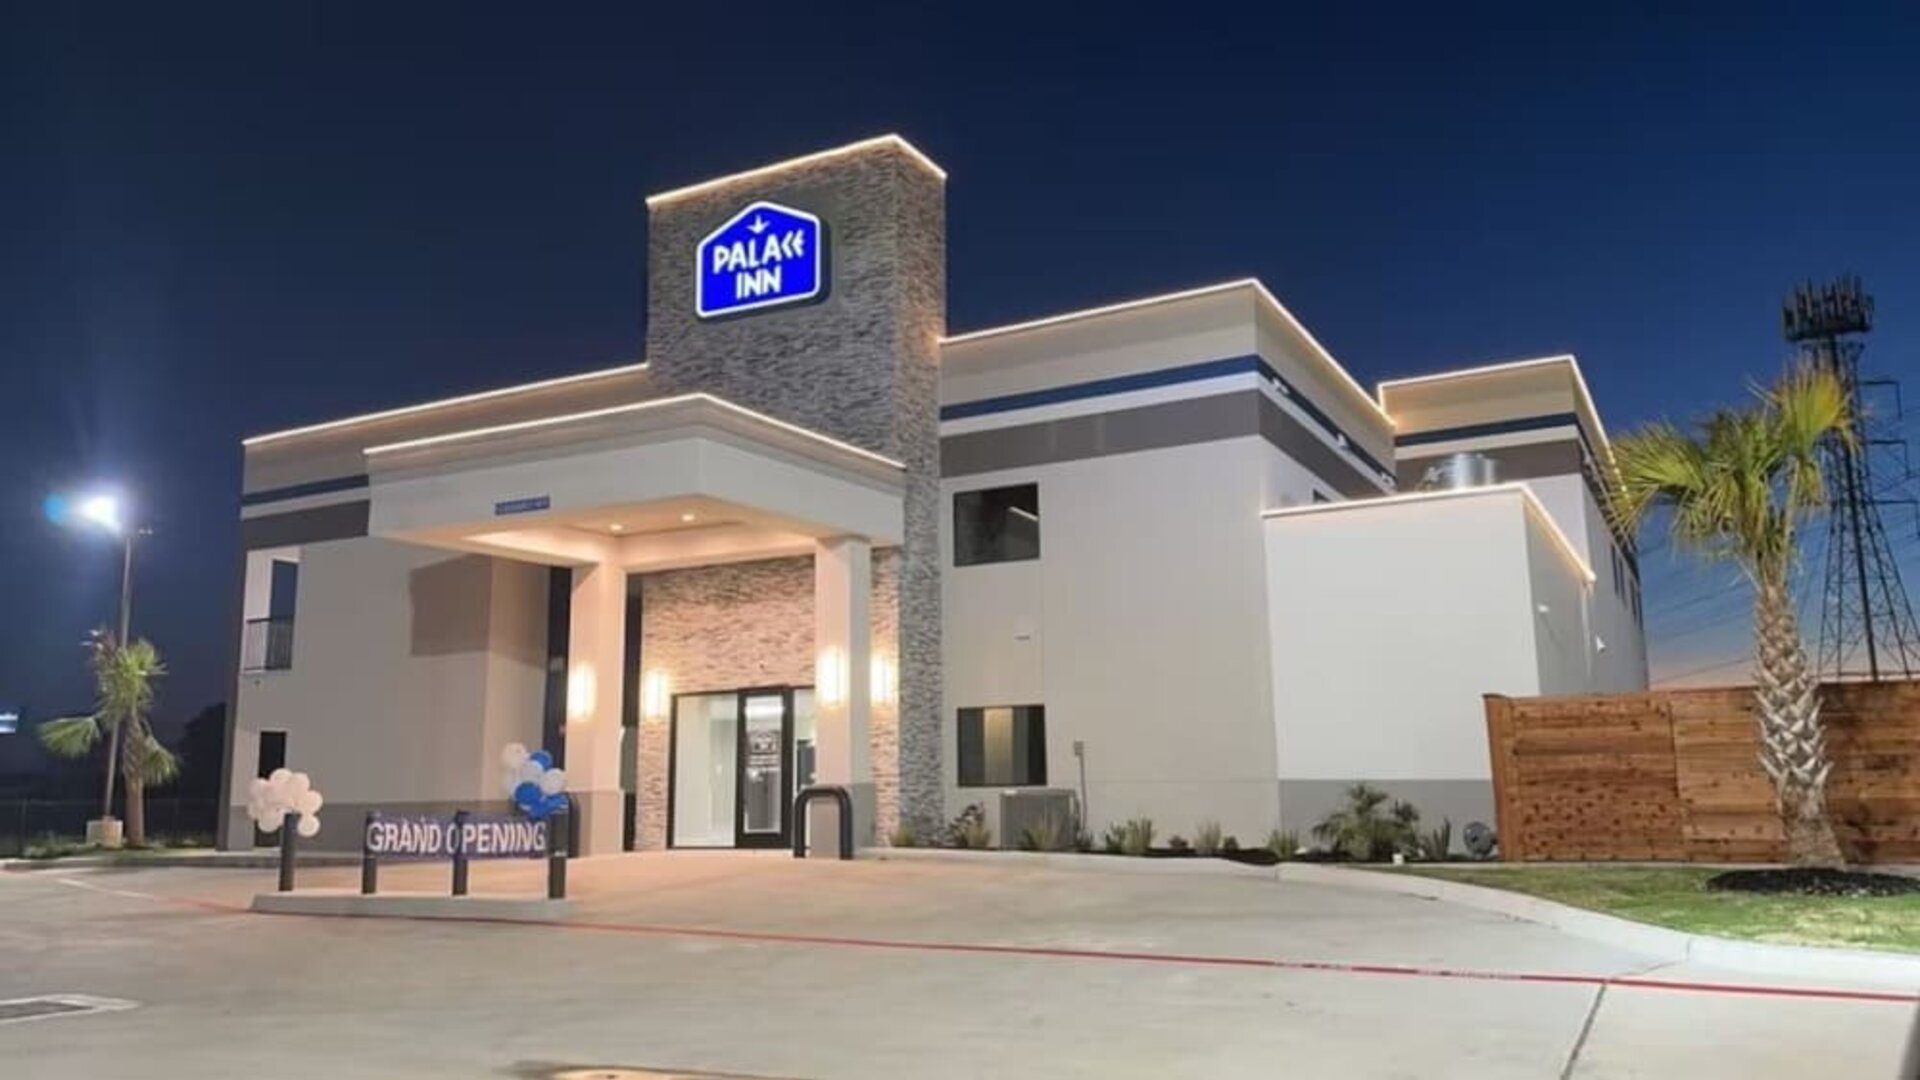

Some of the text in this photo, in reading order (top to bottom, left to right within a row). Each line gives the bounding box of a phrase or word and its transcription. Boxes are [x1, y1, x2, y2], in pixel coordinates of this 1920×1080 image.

[713, 229, 804, 274] PALACE
[736, 264, 781, 299] INN
[366, 821, 546, 853] GRAND OPENING
